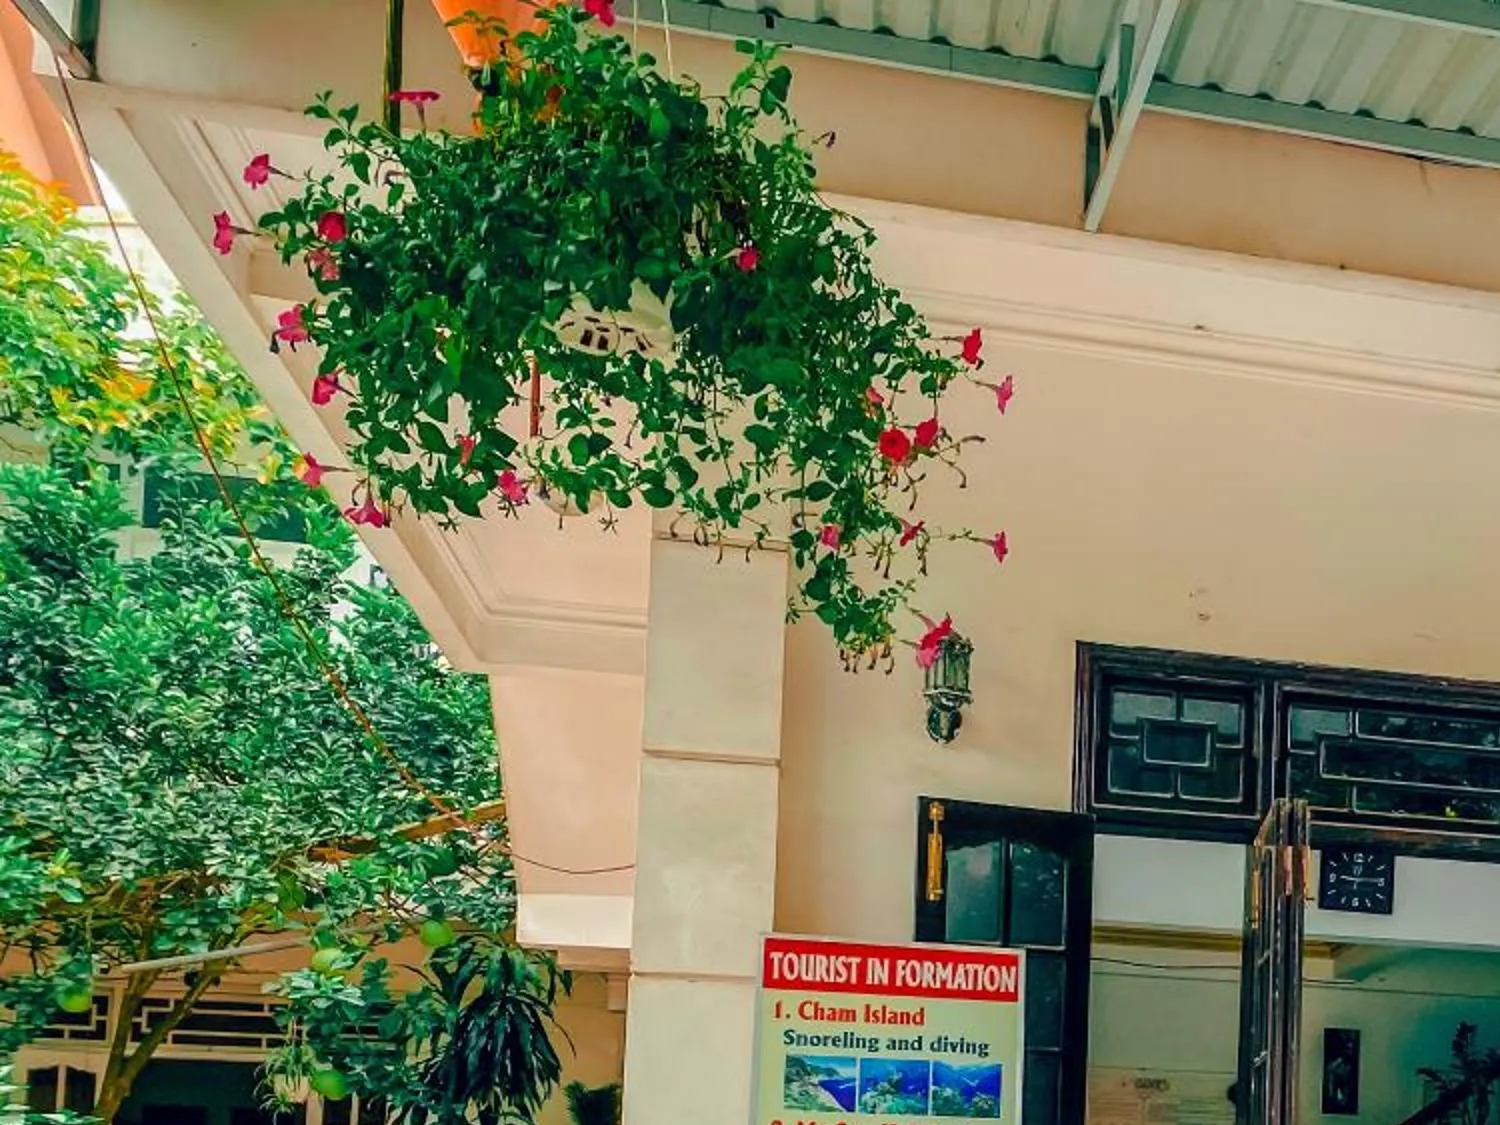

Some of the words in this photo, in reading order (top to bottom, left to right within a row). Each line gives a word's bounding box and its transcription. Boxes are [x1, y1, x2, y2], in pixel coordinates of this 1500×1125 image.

[769, 951, 861, 984] TOURIST
[866, 957, 889, 986] IN
[895, 959, 1018, 993] FORMATION
[773, 1002, 791, 1019] 1.
[798, 1001, 857, 1022] Cham
[864, 1004, 925, 1026] Island
[783, 1029, 879, 1052] Snoreling
[886, 1033, 923, 1052] and
[930, 1034, 990, 1057] diving
